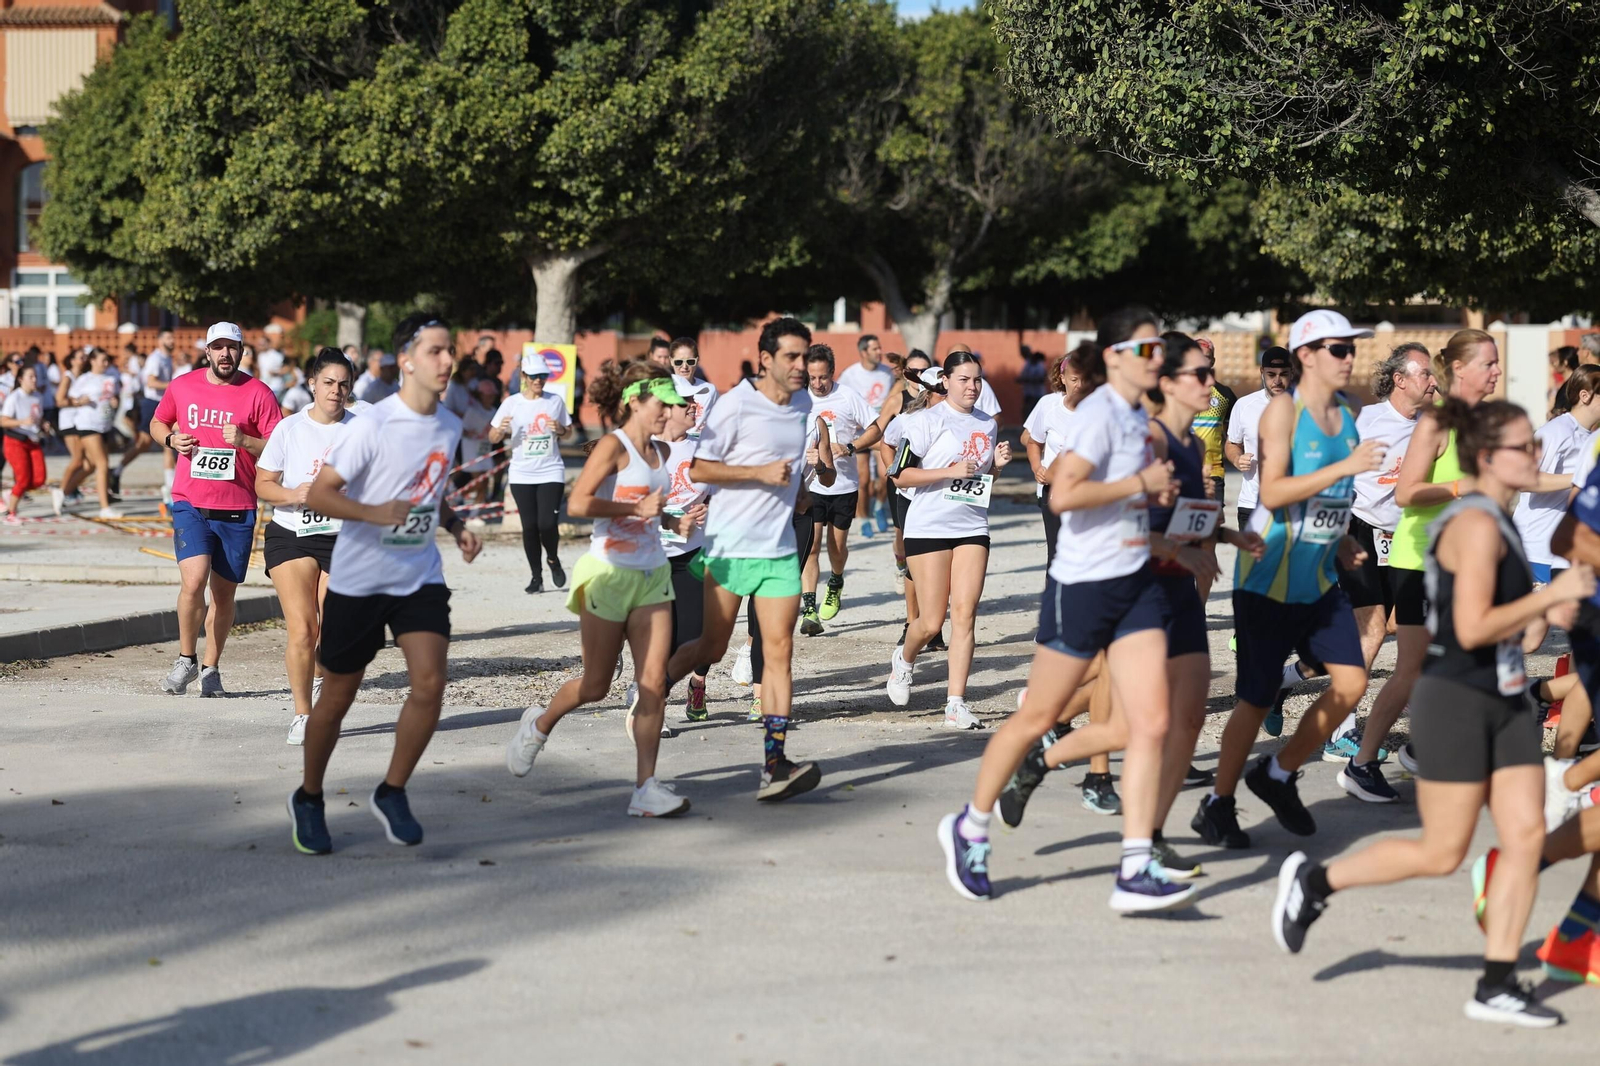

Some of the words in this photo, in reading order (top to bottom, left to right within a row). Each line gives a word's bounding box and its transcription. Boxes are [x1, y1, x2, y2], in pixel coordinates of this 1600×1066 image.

[200, 409, 233, 425] JFIT
[528, 440, 549, 450] 773
[197, 456, 229, 470] 468
[951, 479, 985, 495] 843
[302, 509, 330, 524] 56
[1188, 513, 1207, 531] 16
[1314, 510, 1346, 528] 804
[1381, 540, 1392, 554] 3
